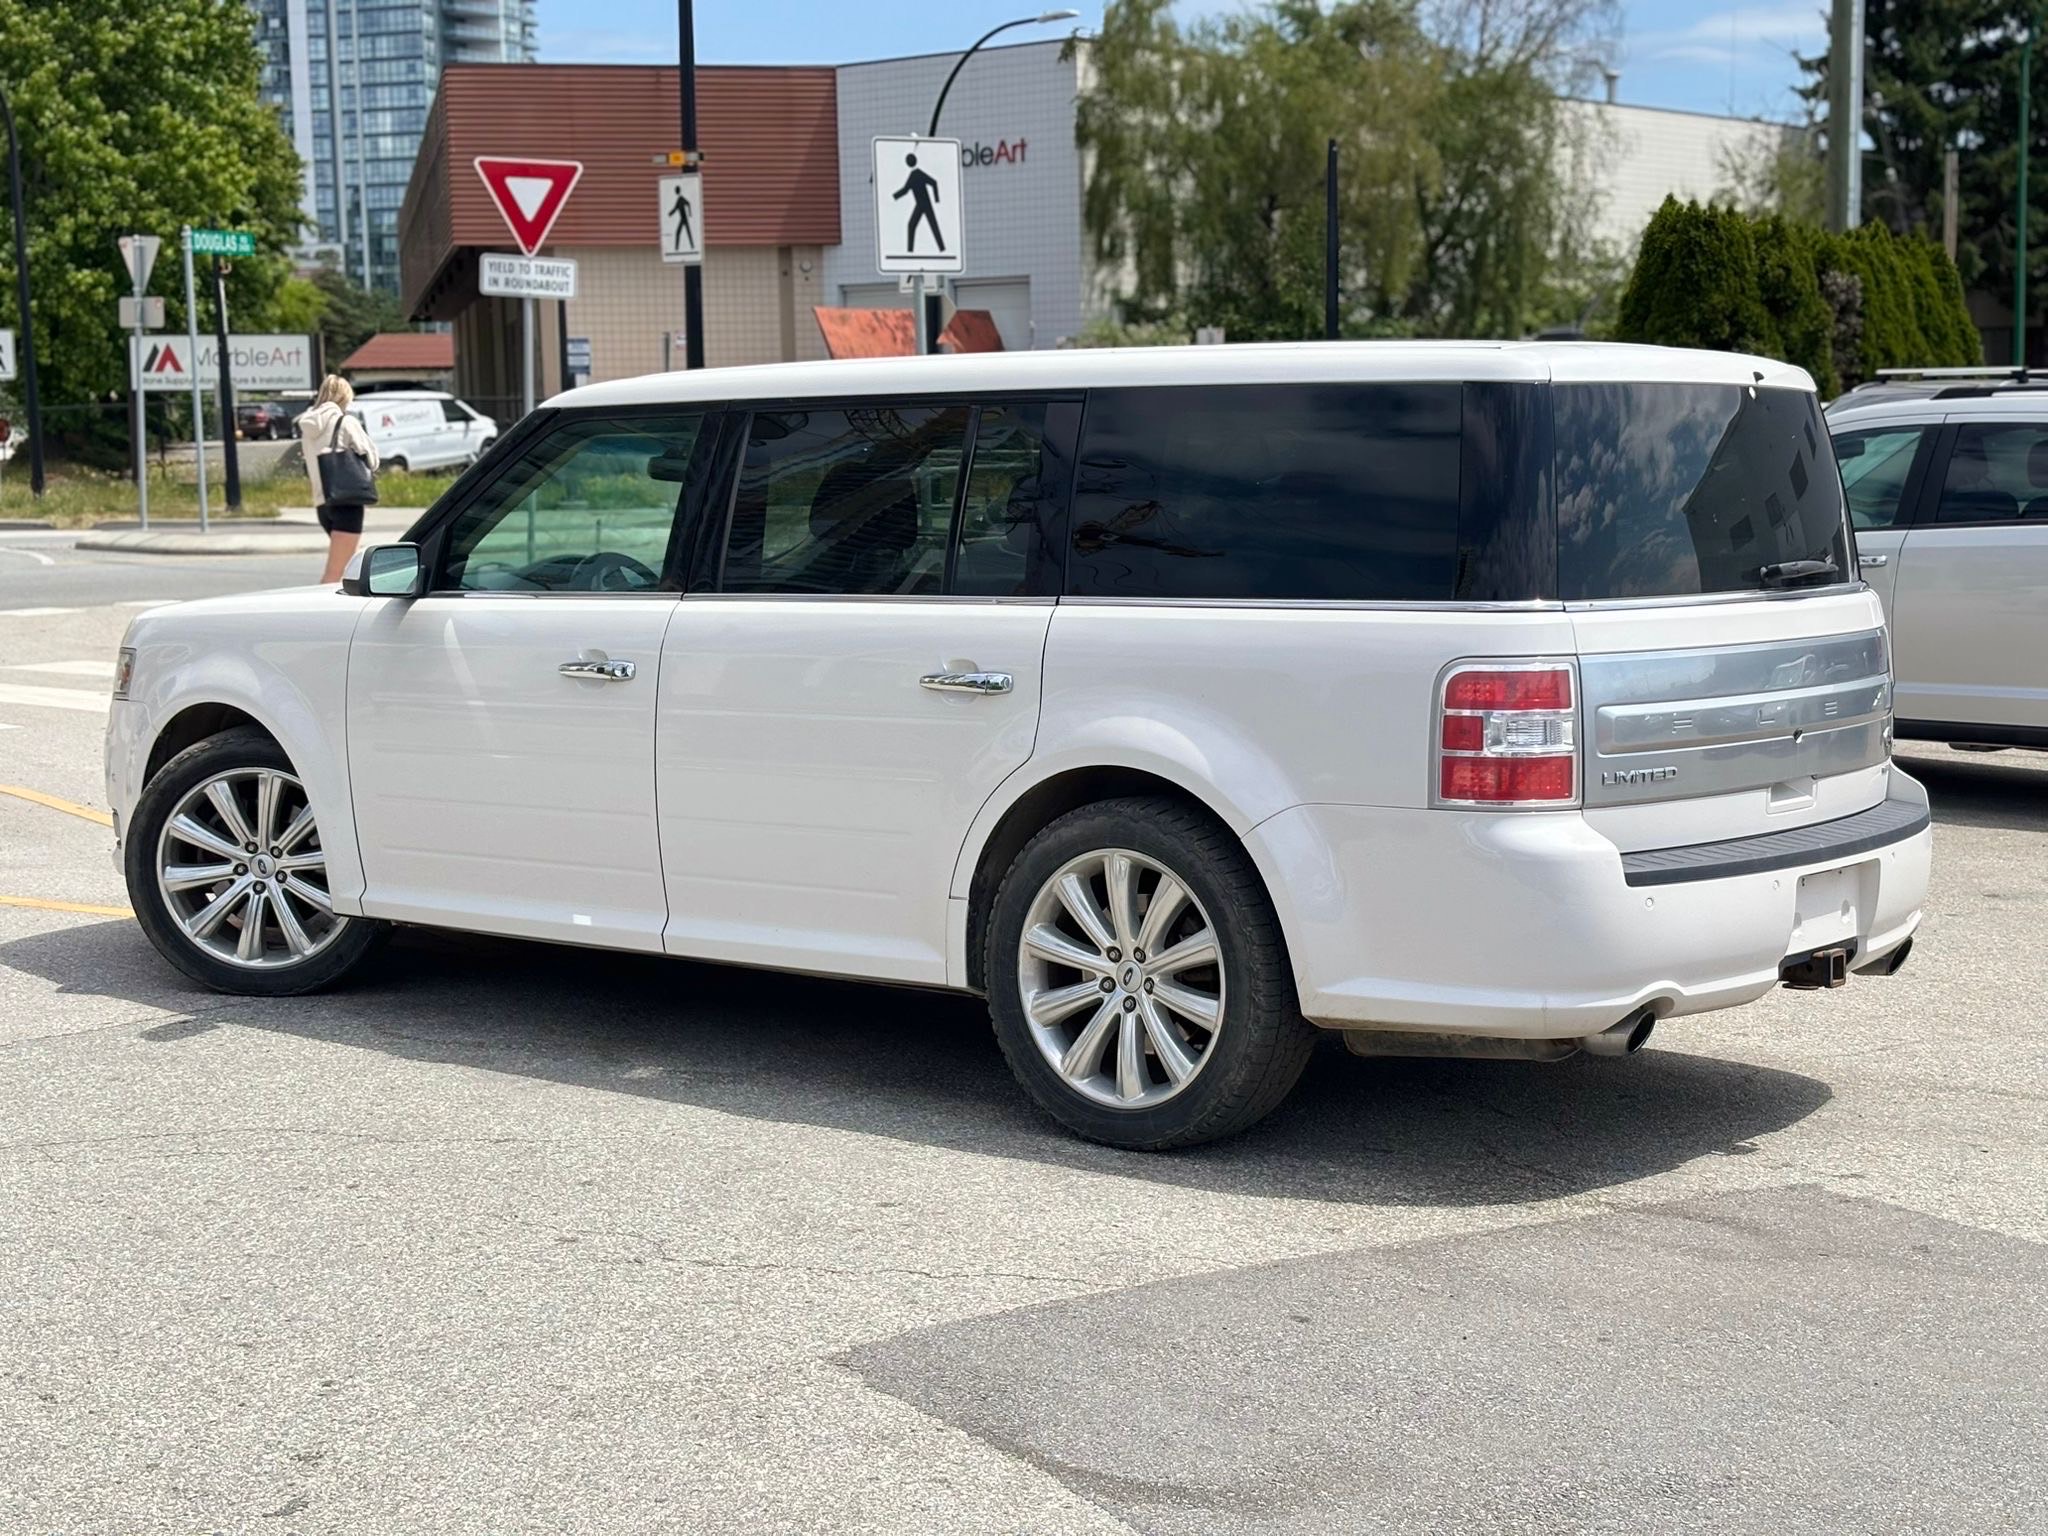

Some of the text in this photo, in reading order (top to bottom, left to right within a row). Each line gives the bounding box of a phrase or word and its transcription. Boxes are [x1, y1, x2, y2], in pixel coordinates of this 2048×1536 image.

[961, 138, 1027, 167] bleArt
[194, 233, 237, 251] DOUGLAS
[488, 261, 571, 278] YIELD TO TRAFFIC
[488, 276, 570, 293] IN ROUNDABOUT
[1602, 766, 1678, 787] LIMITED
